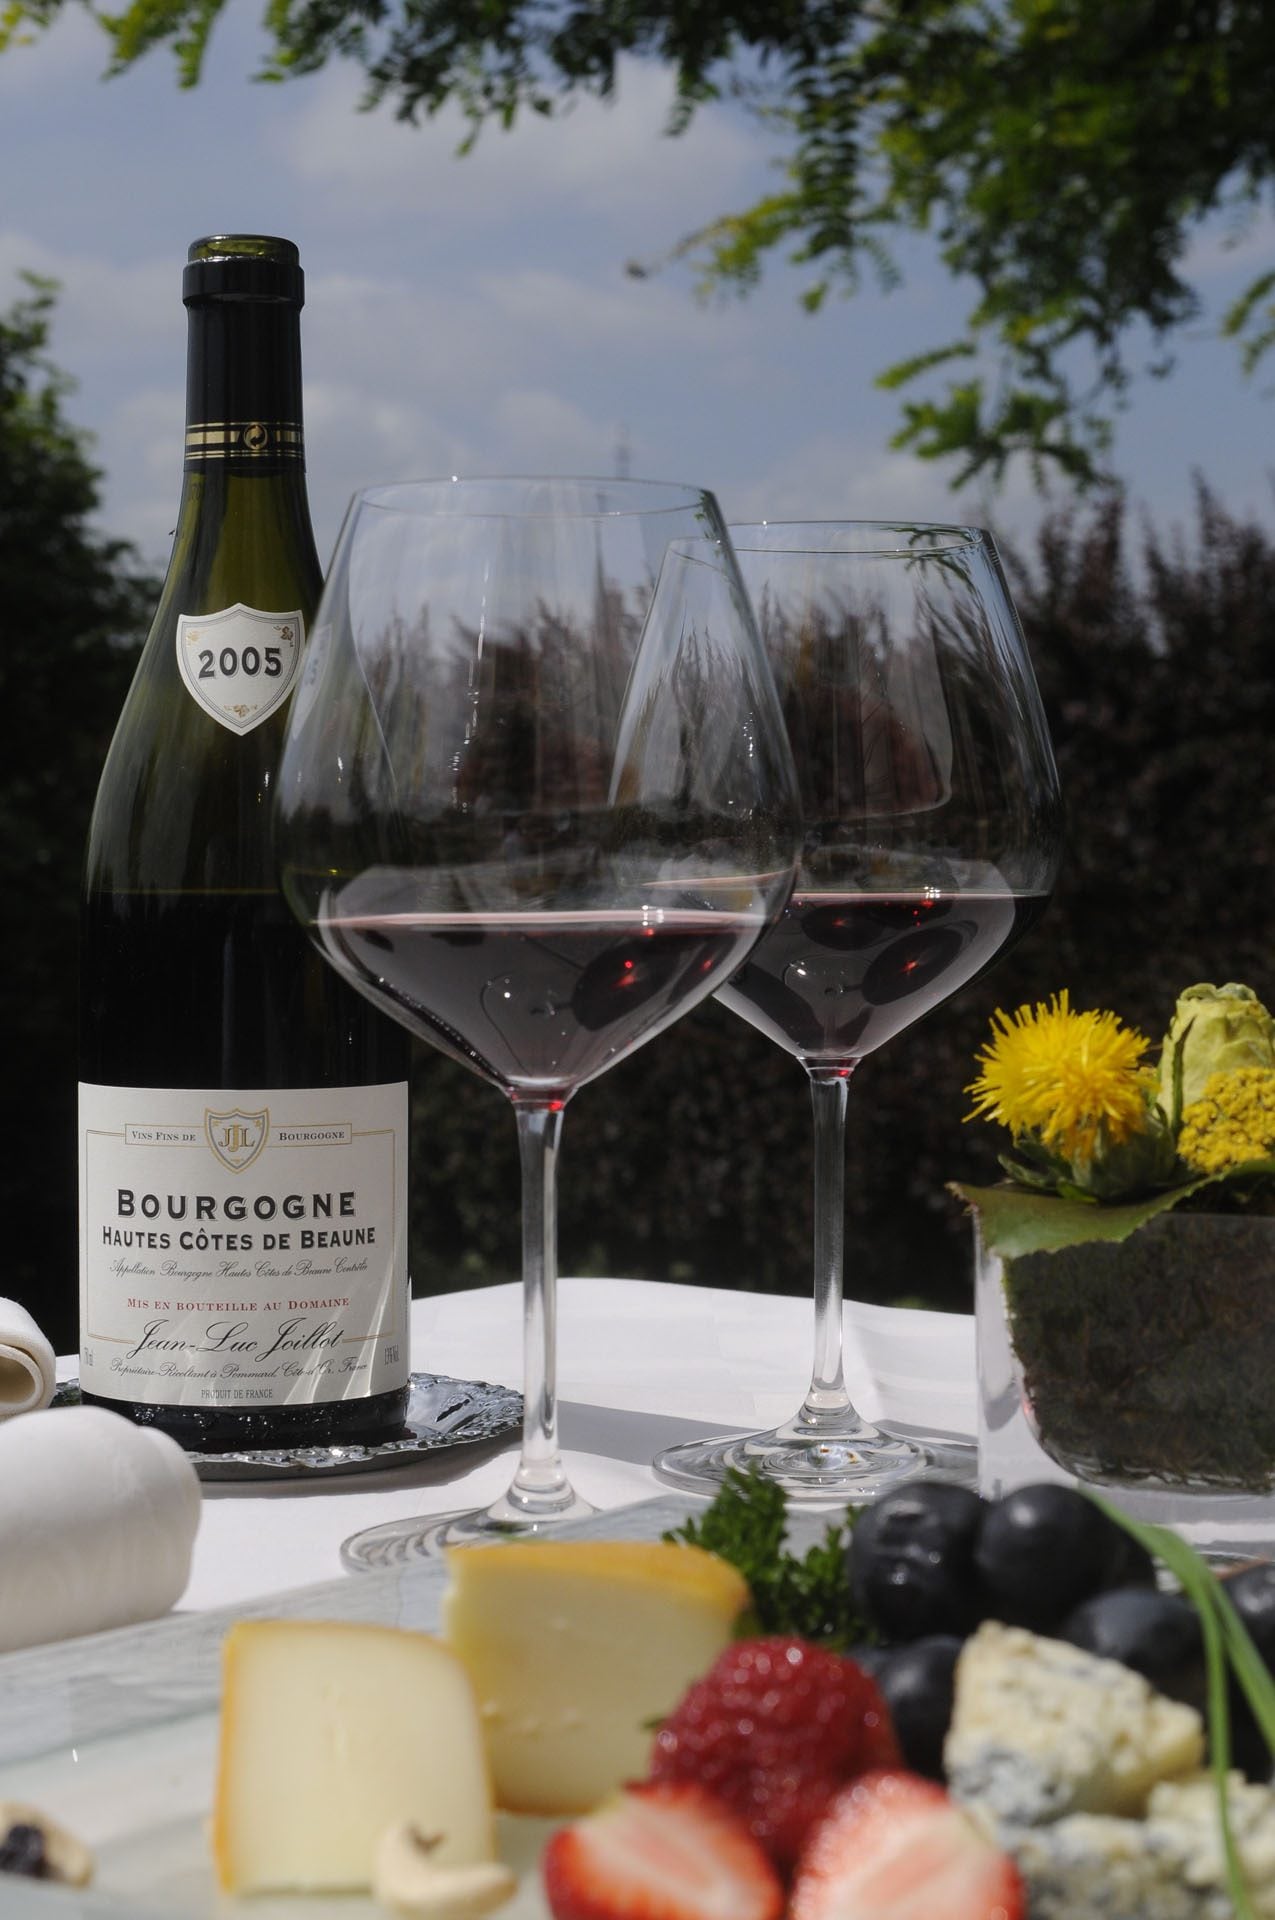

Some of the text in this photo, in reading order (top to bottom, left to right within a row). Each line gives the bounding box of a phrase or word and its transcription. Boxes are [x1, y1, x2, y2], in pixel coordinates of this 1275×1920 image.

[198, 647, 282, 679] 2005
[279, 1130, 345, 1142] BOURGOGNE
[117, 1188, 355, 1221] BOURGOGNE
[102, 1225, 376, 1252] HAUTES CÔTES DE BEAUNE
[109, 1257, 156, 1278] Appellation
[159, 1259, 213, 1281] Bourgogne
[216, 1260, 252, 1278] Hautes
[281, 1264, 293, 1277] de
[294, 1258, 332, 1276] Beaune
[127, 1297, 350, 1312] MIS EN BOUTEILLE AU DOMAINE
[126, 1318, 258, 1360] Jean-Luc
[254, 1317, 345, 1363] Joillot
[200, 1388, 273, 1400] PRODUIT DE FRANCE
